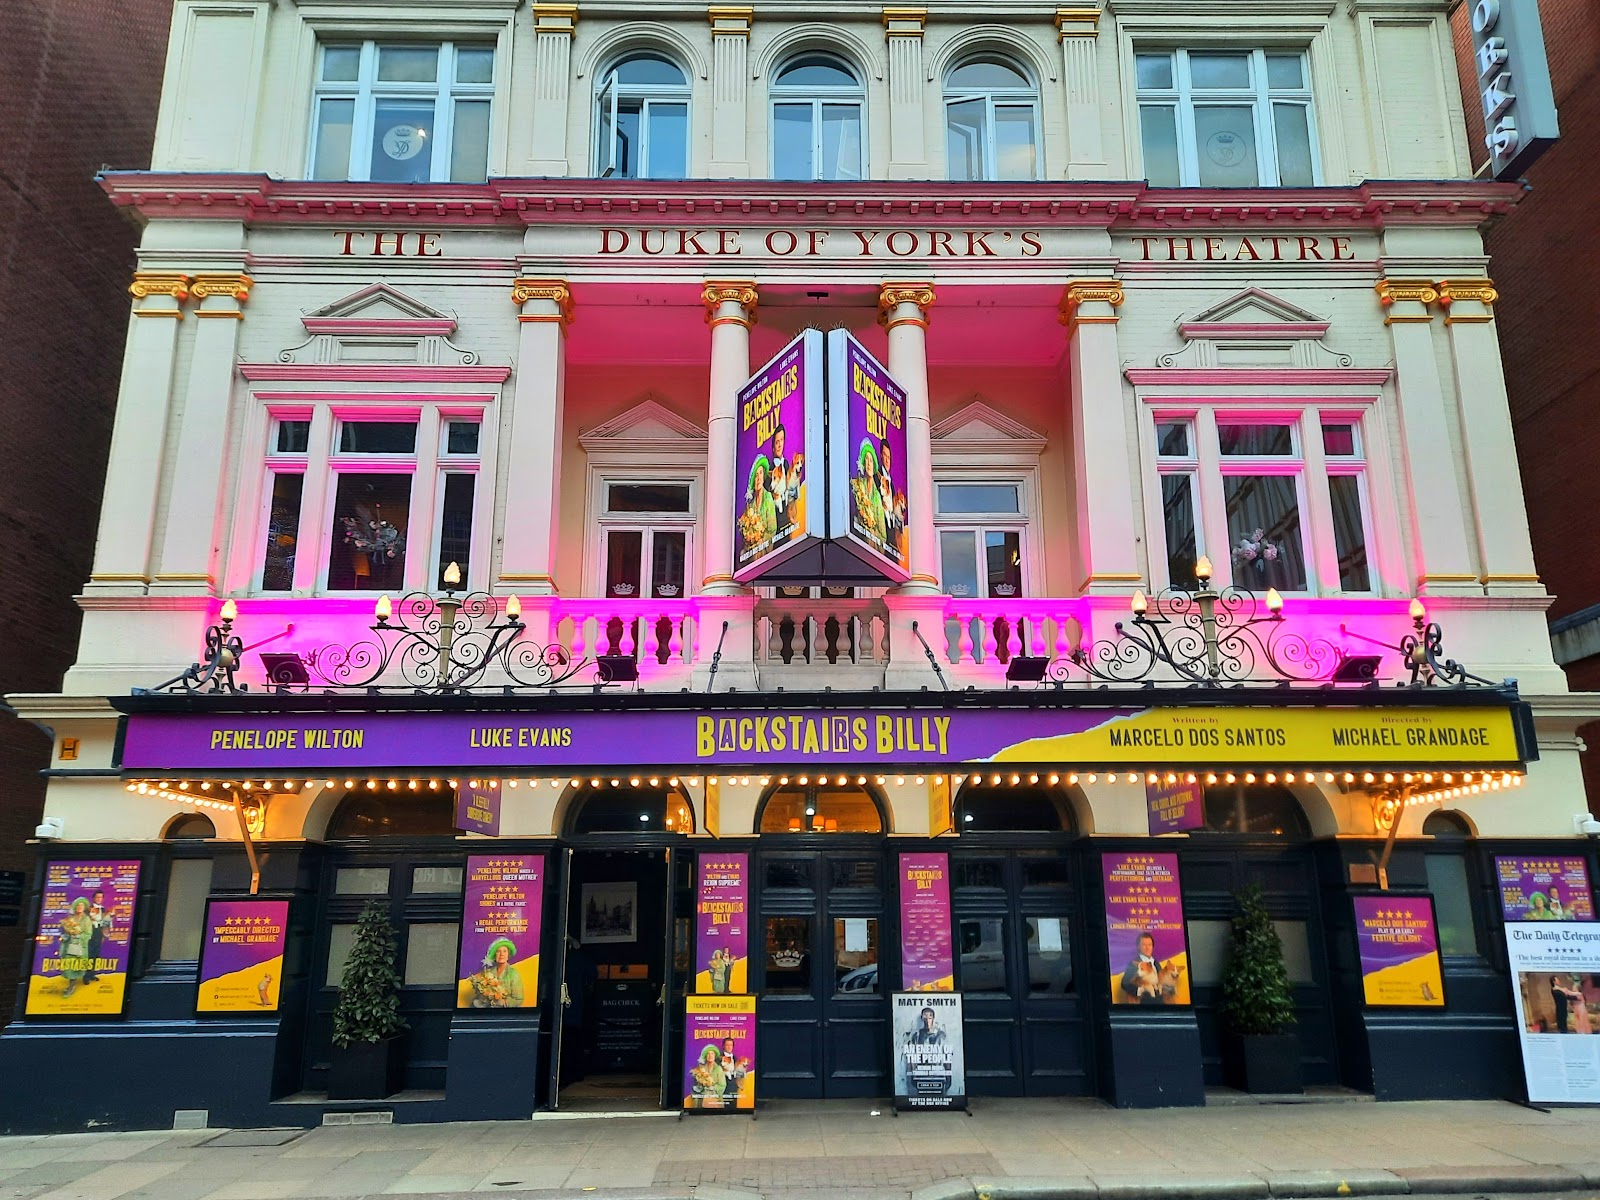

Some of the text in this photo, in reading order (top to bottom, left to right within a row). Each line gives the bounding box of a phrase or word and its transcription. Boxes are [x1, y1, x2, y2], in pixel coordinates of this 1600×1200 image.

[333, 231, 442, 256] THE
[597, 228, 1043, 257] DUKE OF YORK'S
[1130, 236, 1355, 261] THEATRE
[743, 364, 799, 432] BACKSTAIRS
[853, 361, 902, 430] BACKSTAIRS
[756, 404, 781, 449] BILLY
[865, 403, 888, 441] BILLY
[1209, 717, 1219, 725] by
[210, 729, 364, 750] PENELOPE WILTON
[470, 728, 572, 748] LUKE EVANS
[696, 715, 950, 757] BACKSTAIRS BILLY
[1109, 728, 1286, 747] MARCELO DOS SANTOS
[1332, 728, 1490, 746] MICHAEL GRANDAGE
[60, 739, 77, 759] H
[916, 880, 932, 889] BILLY
[712, 913, 731, 924] BILLY
[219, 935, 245, 943] MICHAEL
[1513, 930, 1533, 940] The
[1534, 930, 1561, 942] Daily
[94, 958, 118, 971] BILLY
[898, 998, 956, 1006] MATT SMITH
[731, 1029, 747, 1039] BILLY
[904, 1044, 916, 1053] AN
[916, 1044, 943, 1053] ENEMY
[907, 1053, 953, 1063] THE PEOPLE
